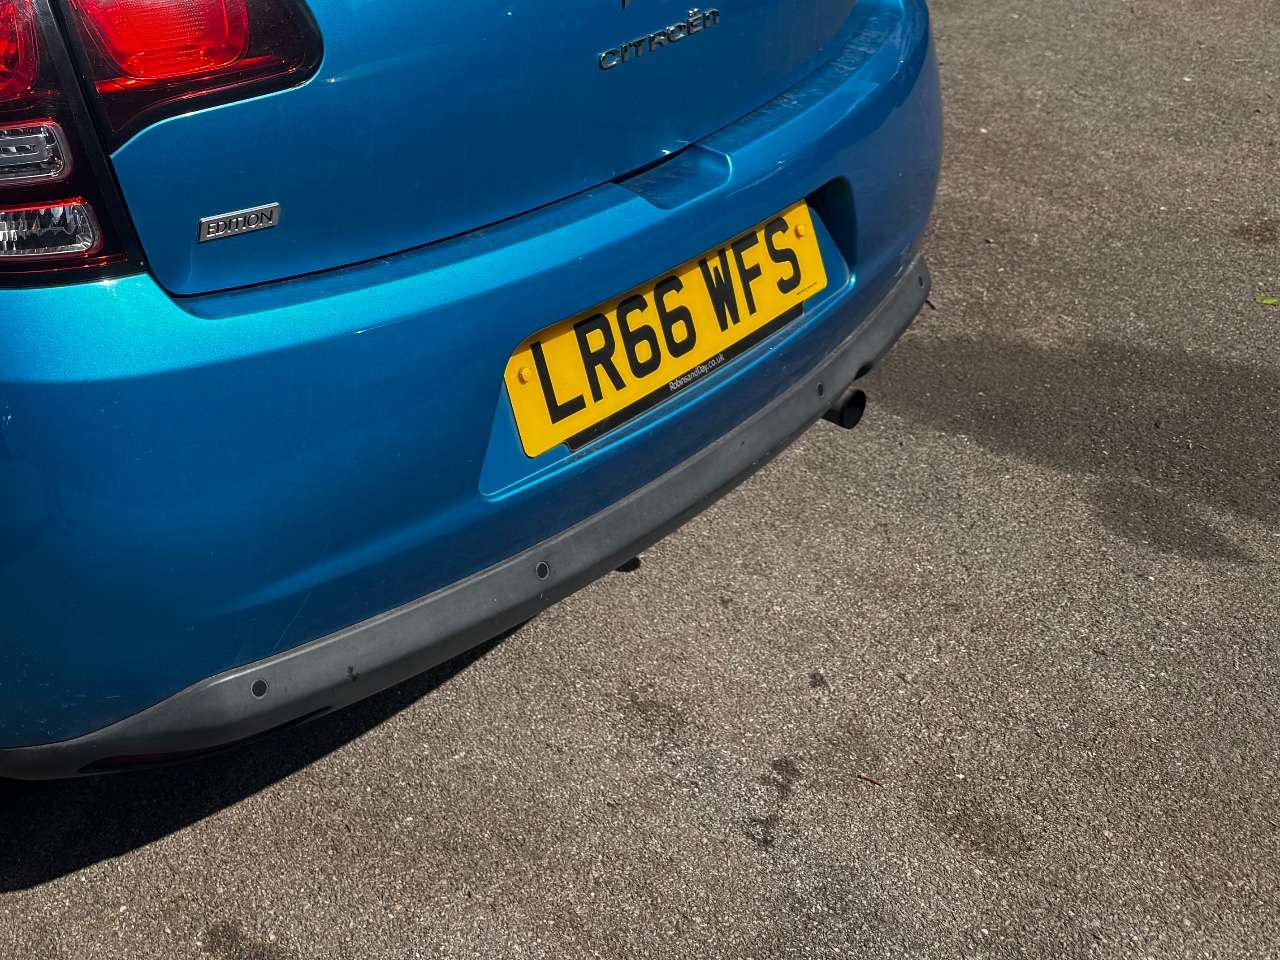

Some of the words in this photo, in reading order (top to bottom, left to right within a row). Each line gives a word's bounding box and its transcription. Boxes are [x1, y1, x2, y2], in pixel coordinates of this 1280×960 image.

[206, 208, 274, 237] EDITION
[530, 274, 697, 424] LR66
[698, 216, 802, 332] WFS
